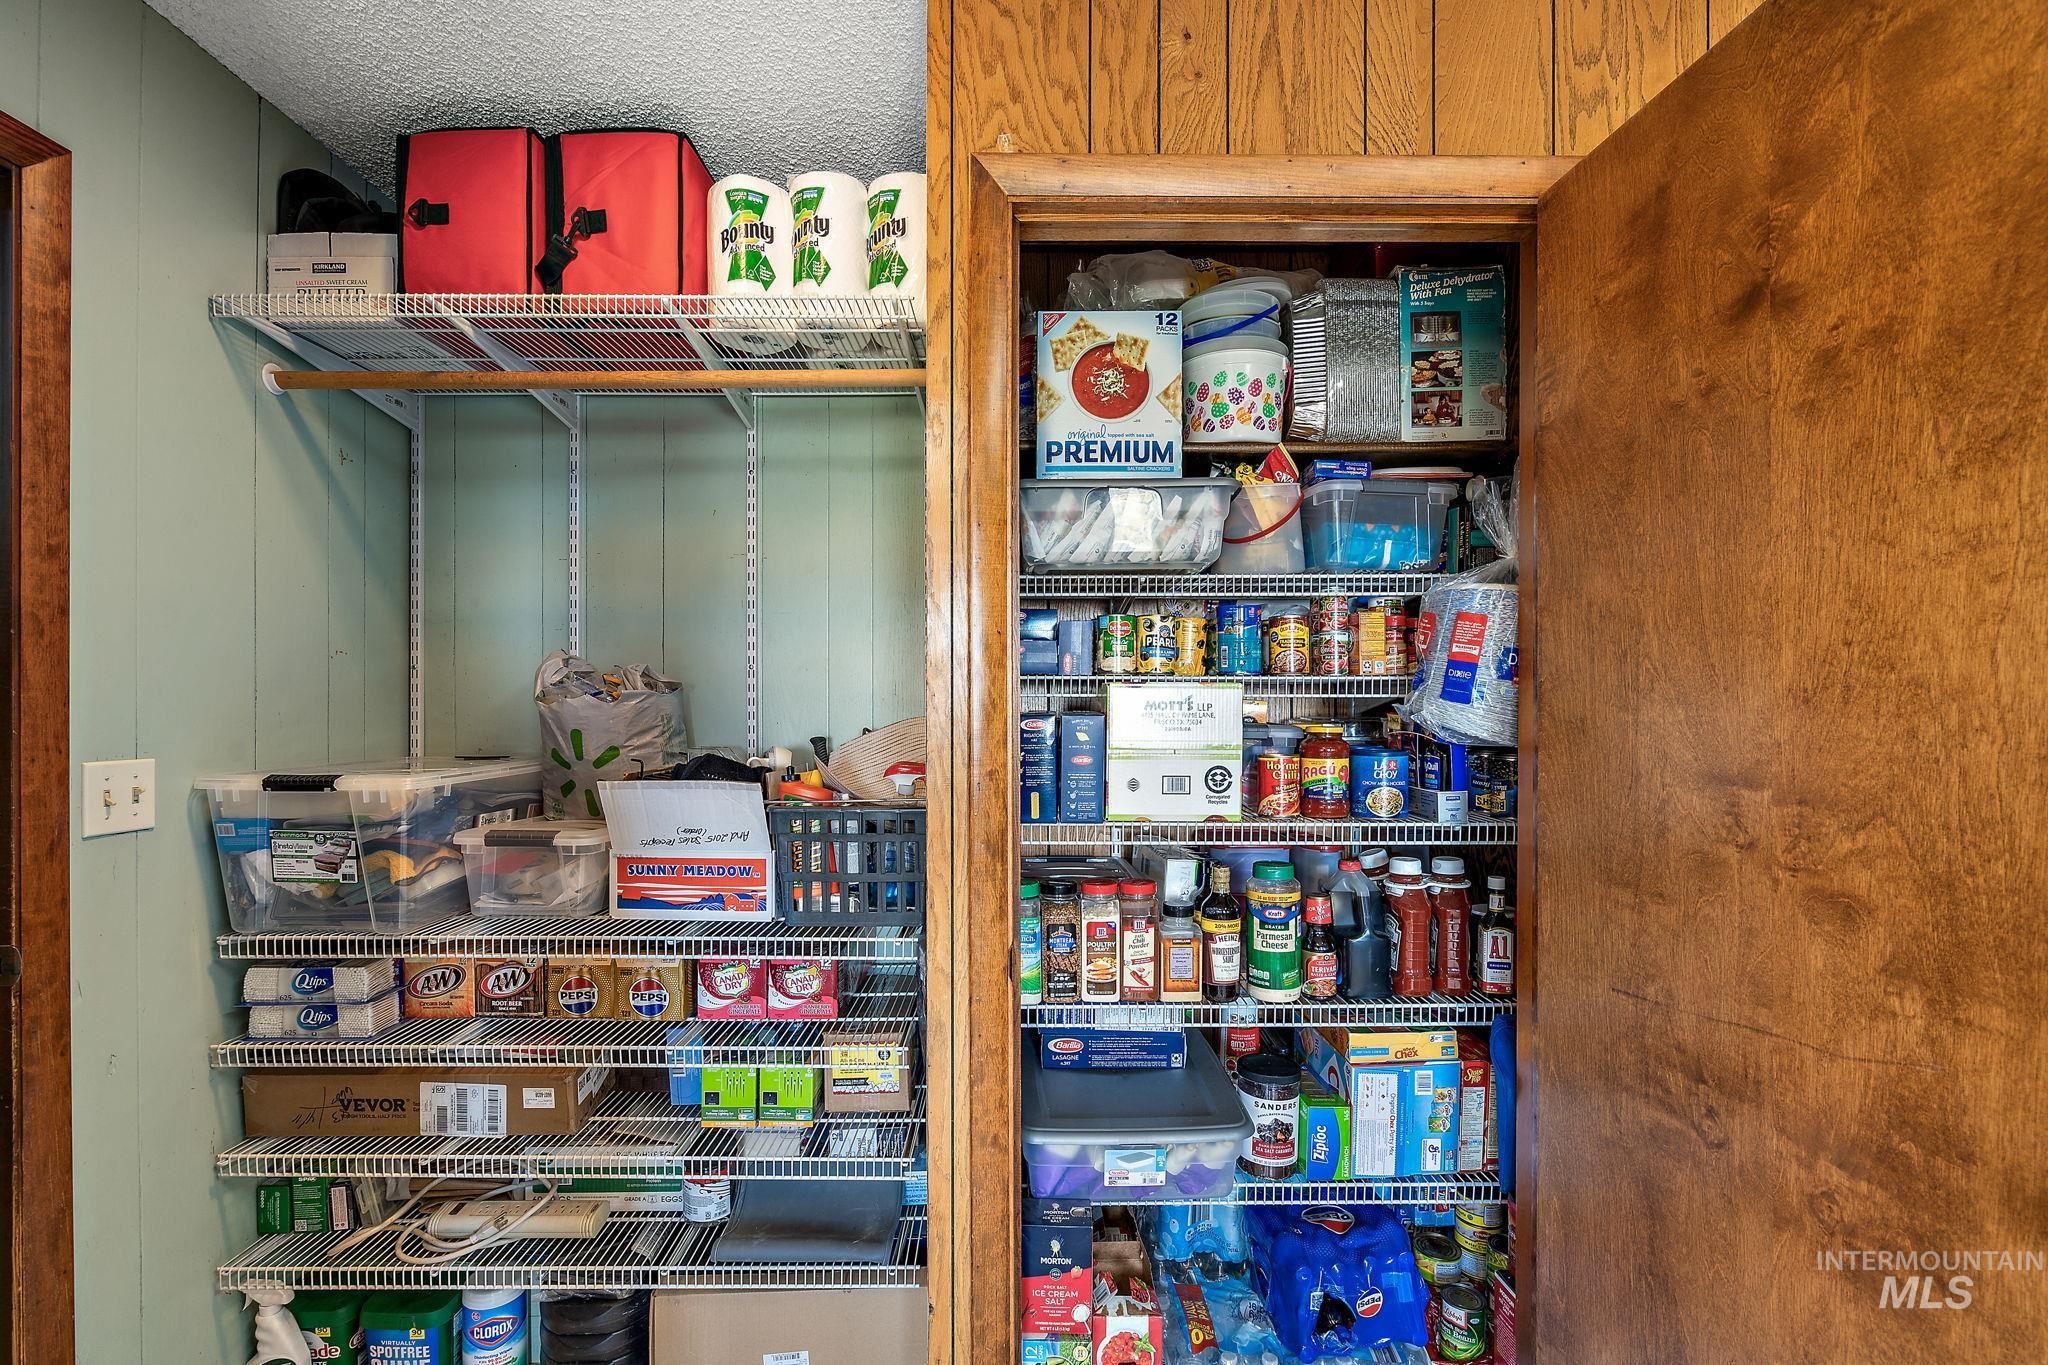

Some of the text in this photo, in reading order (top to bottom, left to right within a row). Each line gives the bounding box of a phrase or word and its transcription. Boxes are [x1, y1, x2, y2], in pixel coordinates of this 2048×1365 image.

[728, 243, 765, 257] Advnced
[1410, 272, 1494, 292] Deluxe Dehydrator
[1410, 287, 1452, 300] With Fan
[1155, 313, 1178, 326] 12
[1067, 424, 1107, 445] original
[1046, 440, 1174, 463] PREMIUM
[1198, 702, 1212, 711] LLP
[1272, 769, 1298, 780] Chili
[1304, 762, 1336, 778] RAGÚ
[1374, 770, 1398, 780] CHOY
[1476, 798, 1505, 810] BUSH'S
[639, 830, 750, 848] And 2015 Sales receipts
[627, 864, 752, 878] SUNNY MEADOW
[1218, 934, 1238, 942] HEINZ
[1256, 931, 1292, 940] Parmesan
[1128, 942, 1150, 950] Powder
[1261, 940, 1288, 949] Cheese
[1222, 956, 1234, 964] SAUCE
[714, 972, 750, 986] CANADA
[784, 973, 821, 987] CANADA
[724, 980, 743, 992] DRY
[796, 982, 814, 993] DRY
[560, 992, 596, 1000] PEPSI
[632, 992, 667, 1002] PEPSI
[1056, 1041, 1080, 1049] Barilla
[1230, 1040, 1244, 1048] CLUB
[1394, 1050, 1418, 1060] Chex
[1464, 1068, 1484, 1082] Stove
[1471, 1074, 1481, 1084] Top
[340, 1098, 406, 1112] VEVOR
[1254, 1101, 1296, 1110] SANDERS
[1314, 1124, 1330, 1160] Ziploc
[1051, 1290, 1078, 1298] CREAM
[1357, 1296, 1380, 1309] PEPSI
[1182, 1300, 1196, 1319] VALUE
[1195, 1300, 1210, 1320] PACK
[1444, 1304, 1463, 1322] Libby's
[474, 1318, 513, 1340] CLOROX
[1454, 1326, 1468, 1336] Style
[1452, 1330, 1476, 1344] Beans
[370, 1346, 430, 1358] SPOTFREE
[1026, 1346, 1038, 1359] 12
